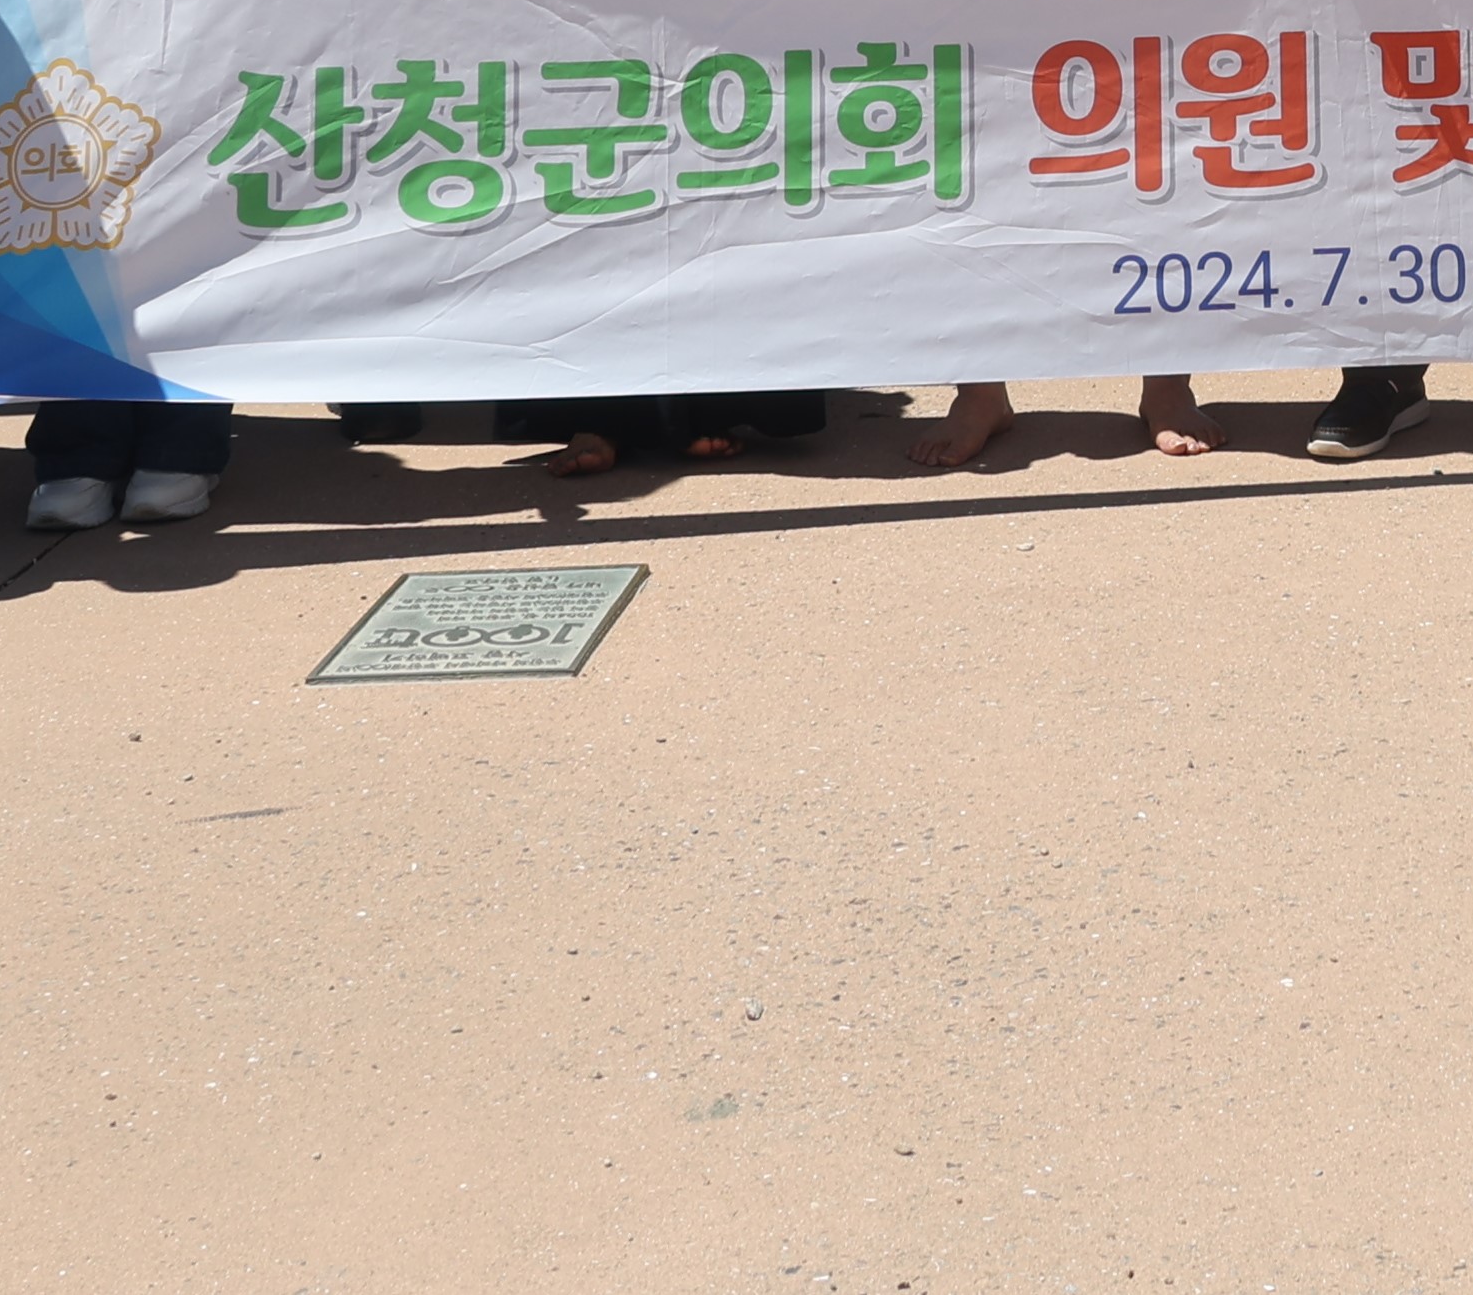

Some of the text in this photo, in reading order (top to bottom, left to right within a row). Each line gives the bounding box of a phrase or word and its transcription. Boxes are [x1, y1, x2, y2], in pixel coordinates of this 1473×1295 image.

[20, 140, 92, 182] 의회
[210, 42, 962, 227] 산청군의회
[1030, 31, 1315, 193] 의원
[1112, 250, 1294, 315] 2024.
[1312, 247, 1368, 307] 7.
